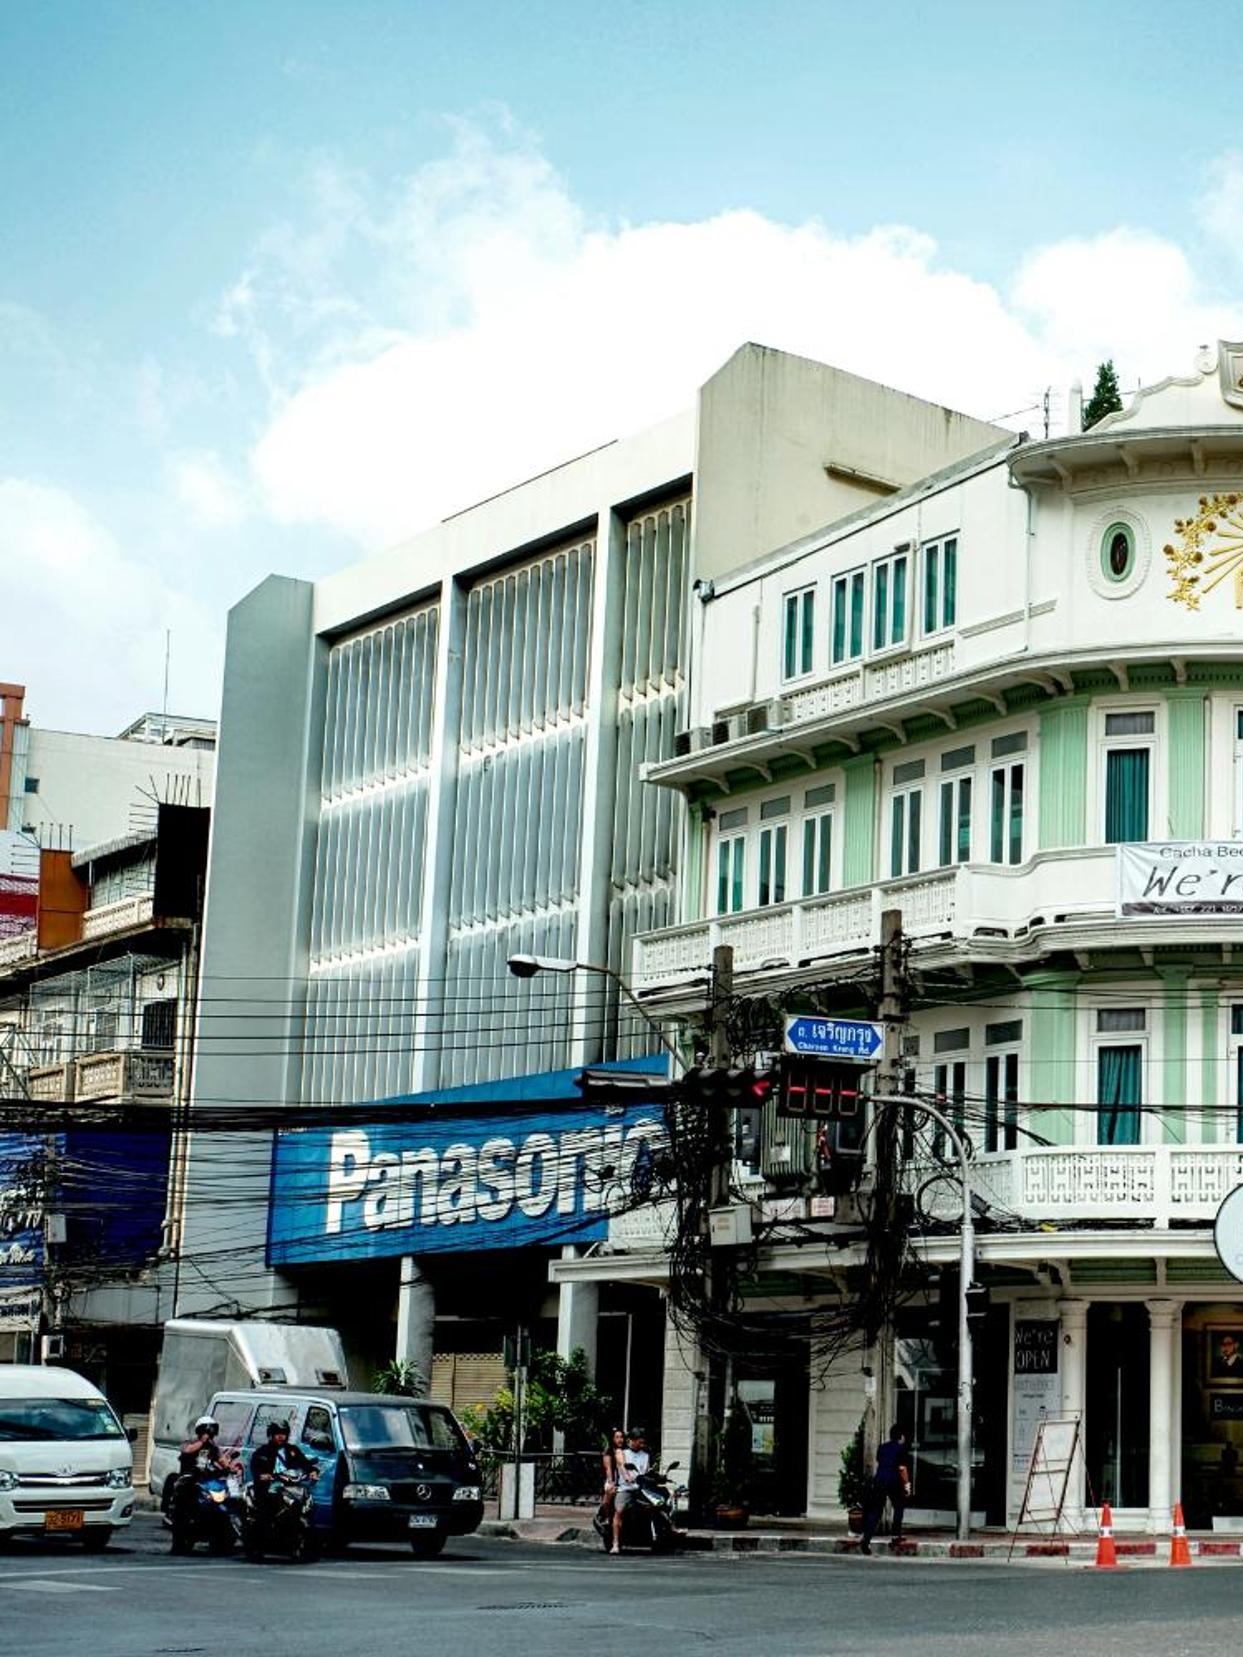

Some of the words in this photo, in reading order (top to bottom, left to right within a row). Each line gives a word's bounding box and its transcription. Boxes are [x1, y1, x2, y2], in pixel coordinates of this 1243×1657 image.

[1160, 846, 1212, 858] Cacha
[812, 1022, 872, 1046] เจริญกรุง
[1016, 1350, 1050, 1369] OPEN
